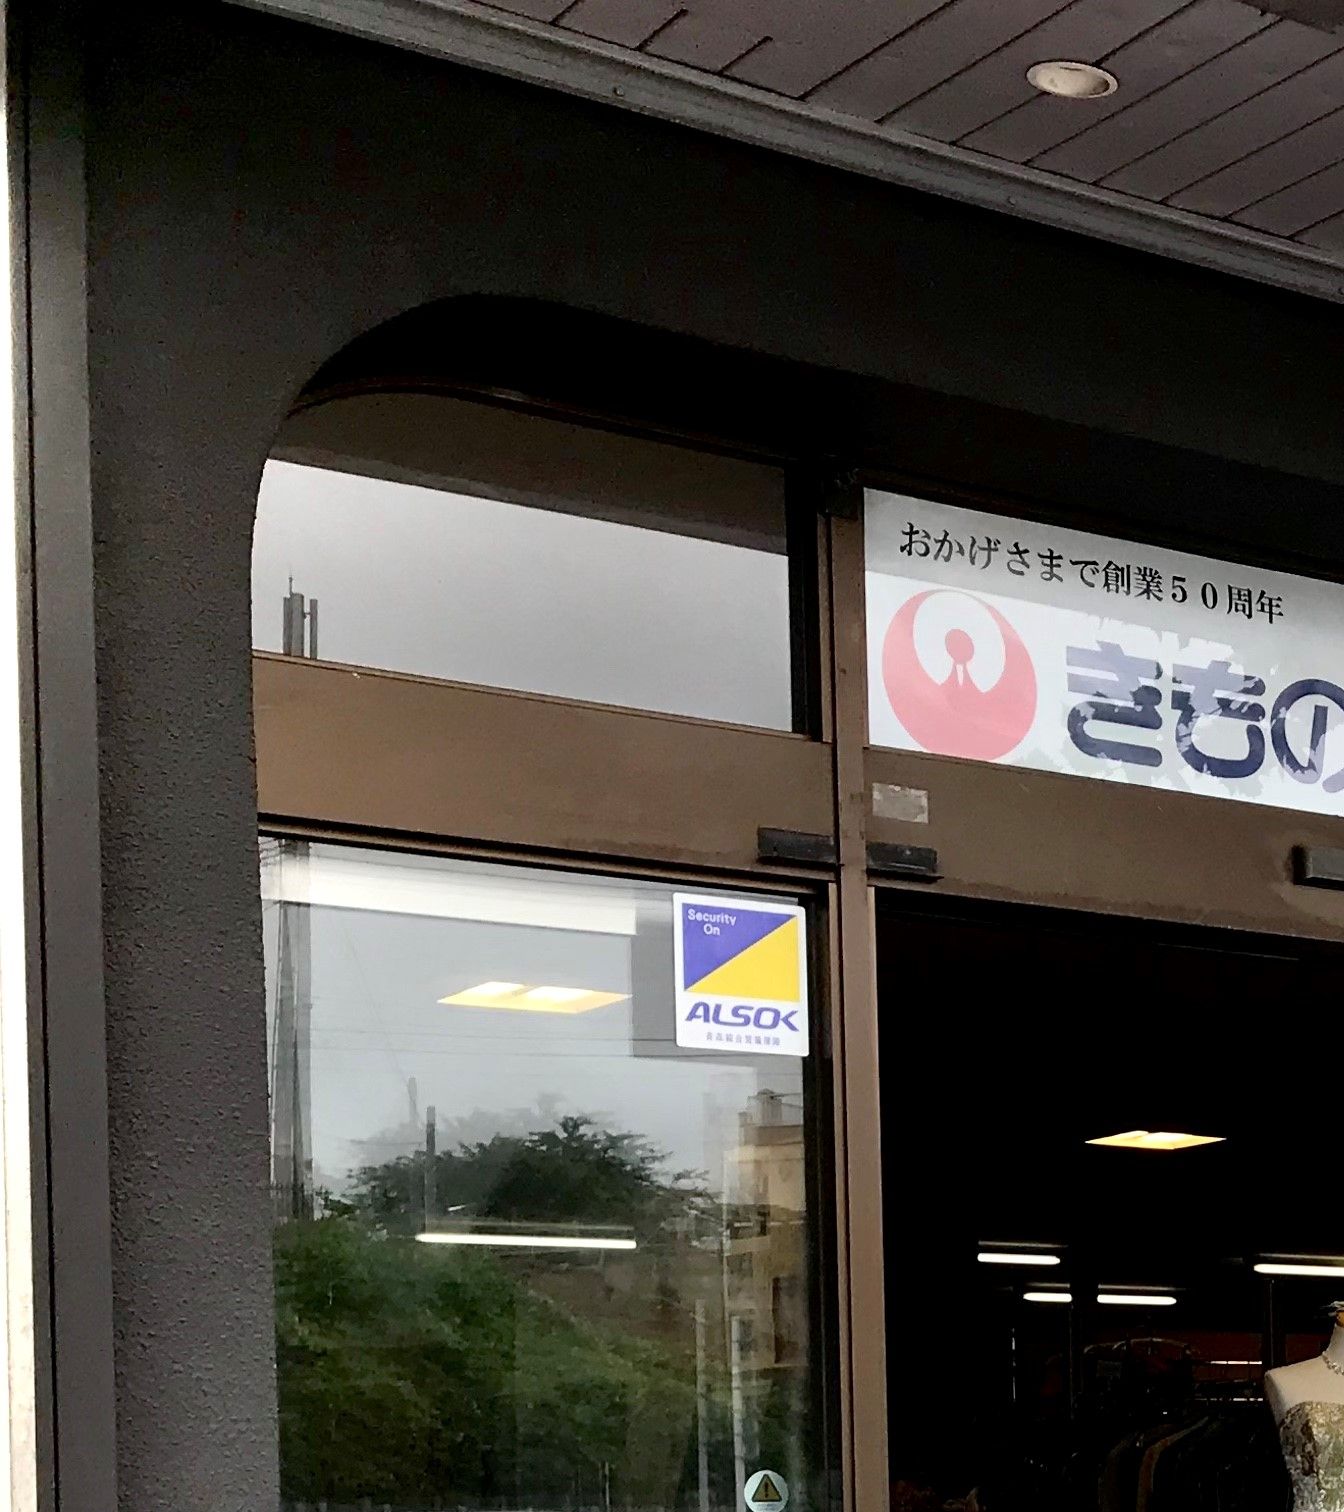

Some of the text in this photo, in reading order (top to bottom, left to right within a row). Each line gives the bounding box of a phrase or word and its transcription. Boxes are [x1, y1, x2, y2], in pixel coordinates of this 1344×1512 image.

[687, 908, 737, 927] Security
[703, 923, 721, 936] On
[685, 1001, 800, 1032] ALSOK
